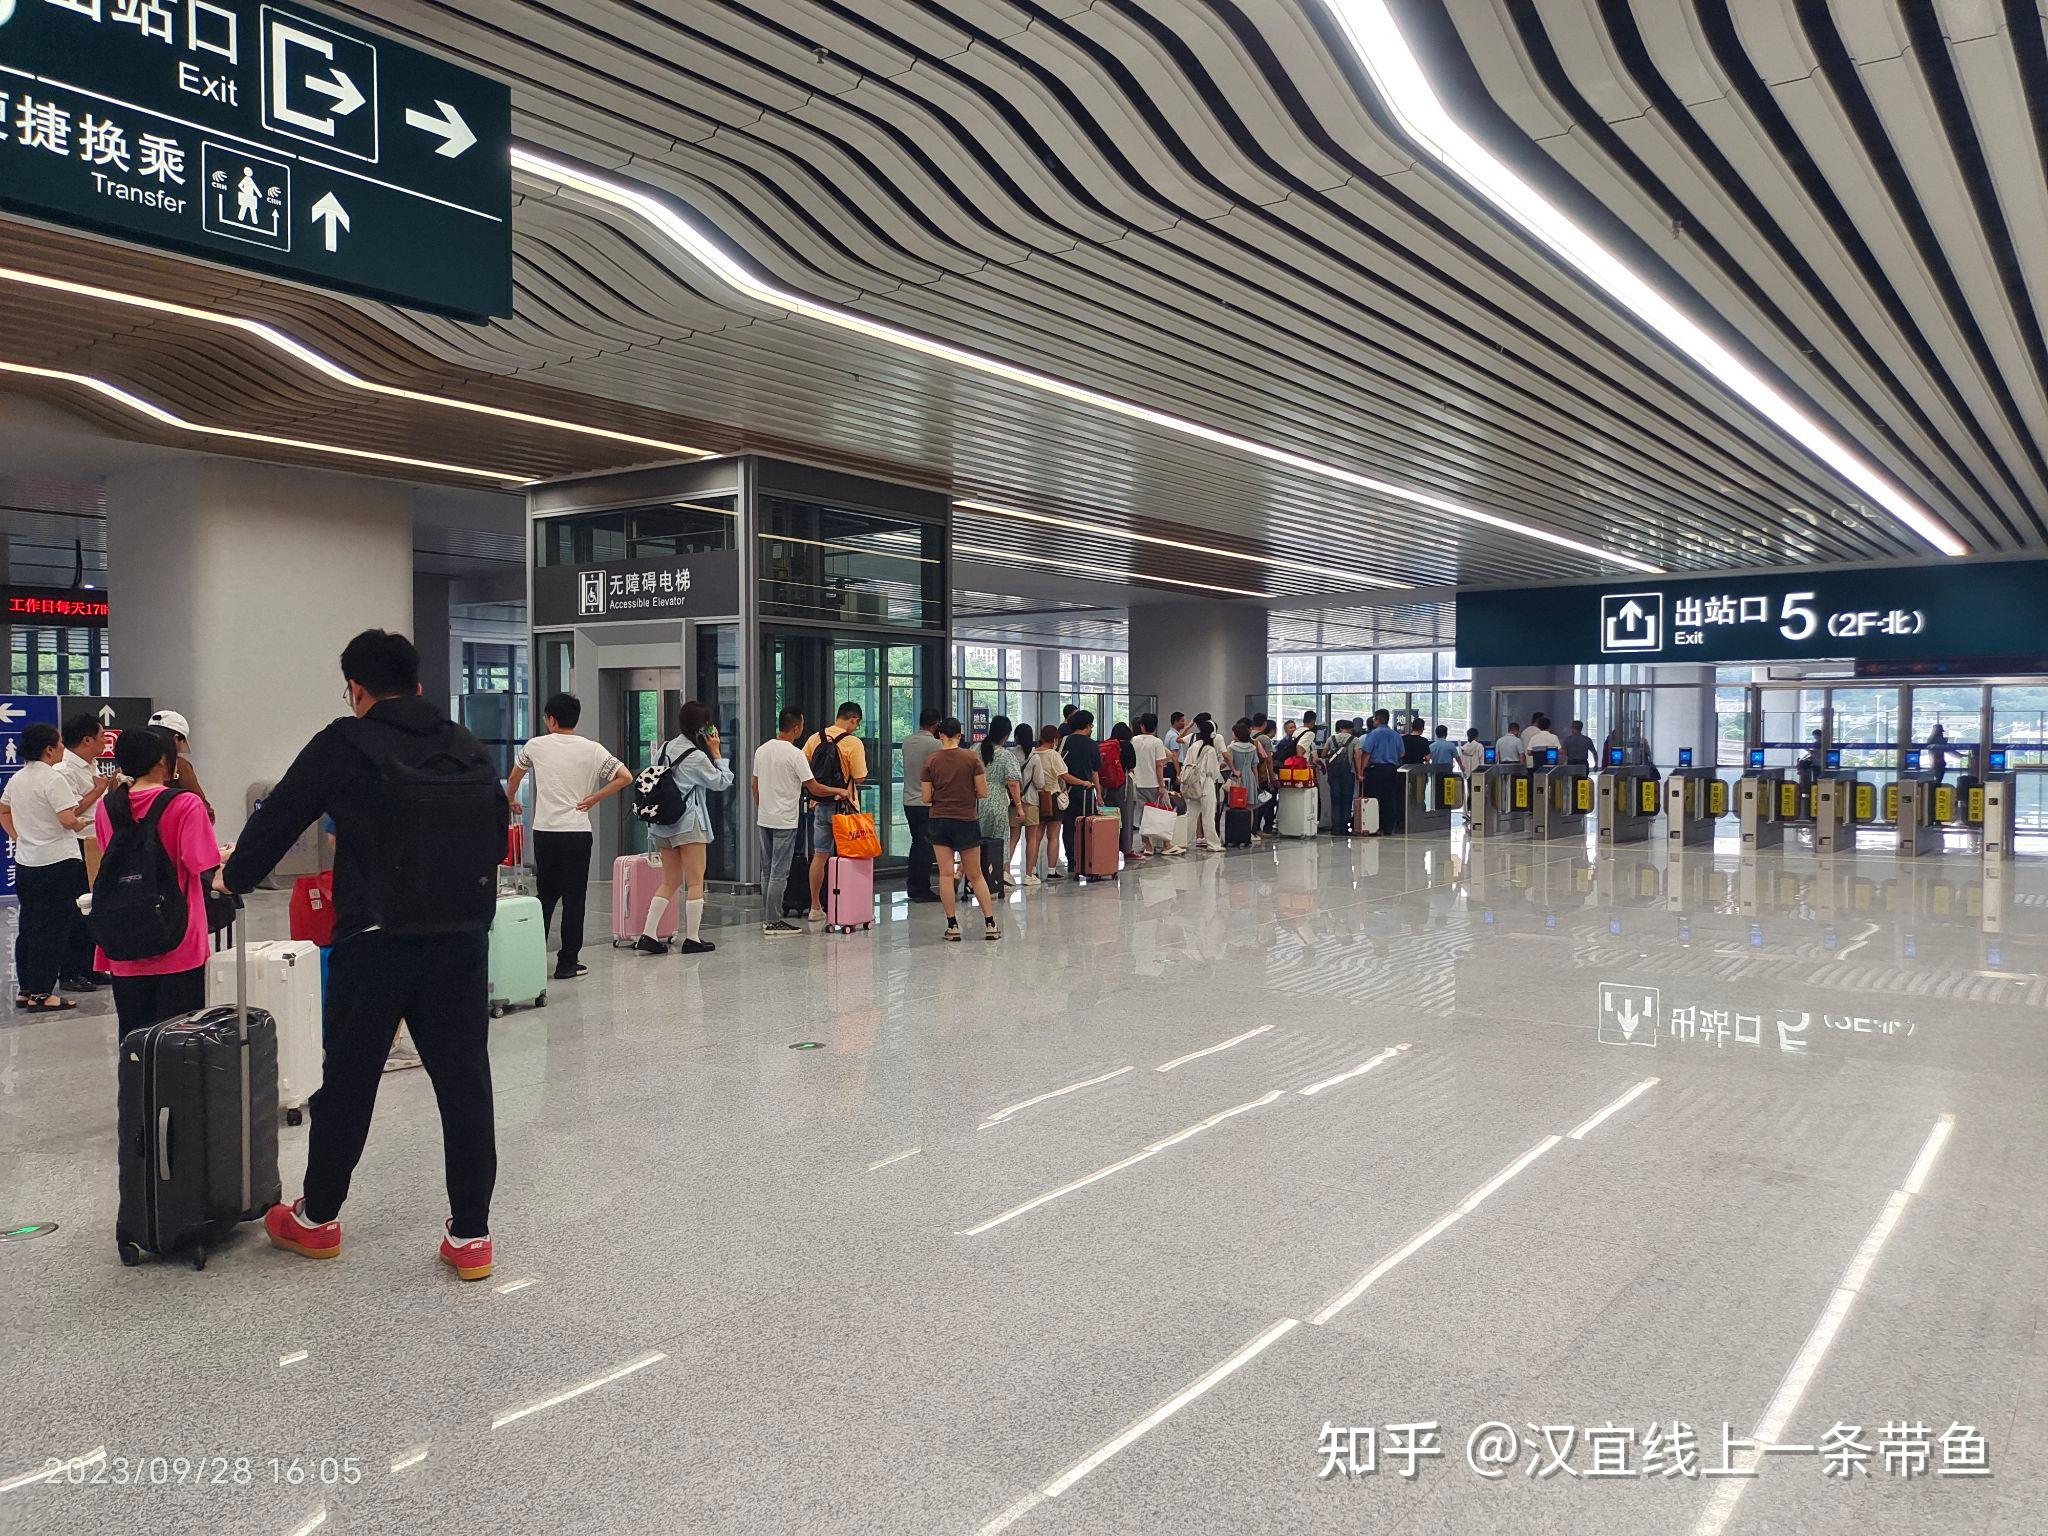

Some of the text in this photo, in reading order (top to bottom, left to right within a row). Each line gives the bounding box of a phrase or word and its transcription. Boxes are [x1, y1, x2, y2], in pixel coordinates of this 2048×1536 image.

[179, 61, 239, 107] Exit
[91, 172, 187, 214] Transfer
[609, 568, 691, 596] 无障碍电梯
[609, 596, 686, 610] Accessible Elevator
[1674, 594, 1768, 627] 出站口
[1779, 592, 1818, 641] 5
[1674, 631, 1704, 645] Exit
